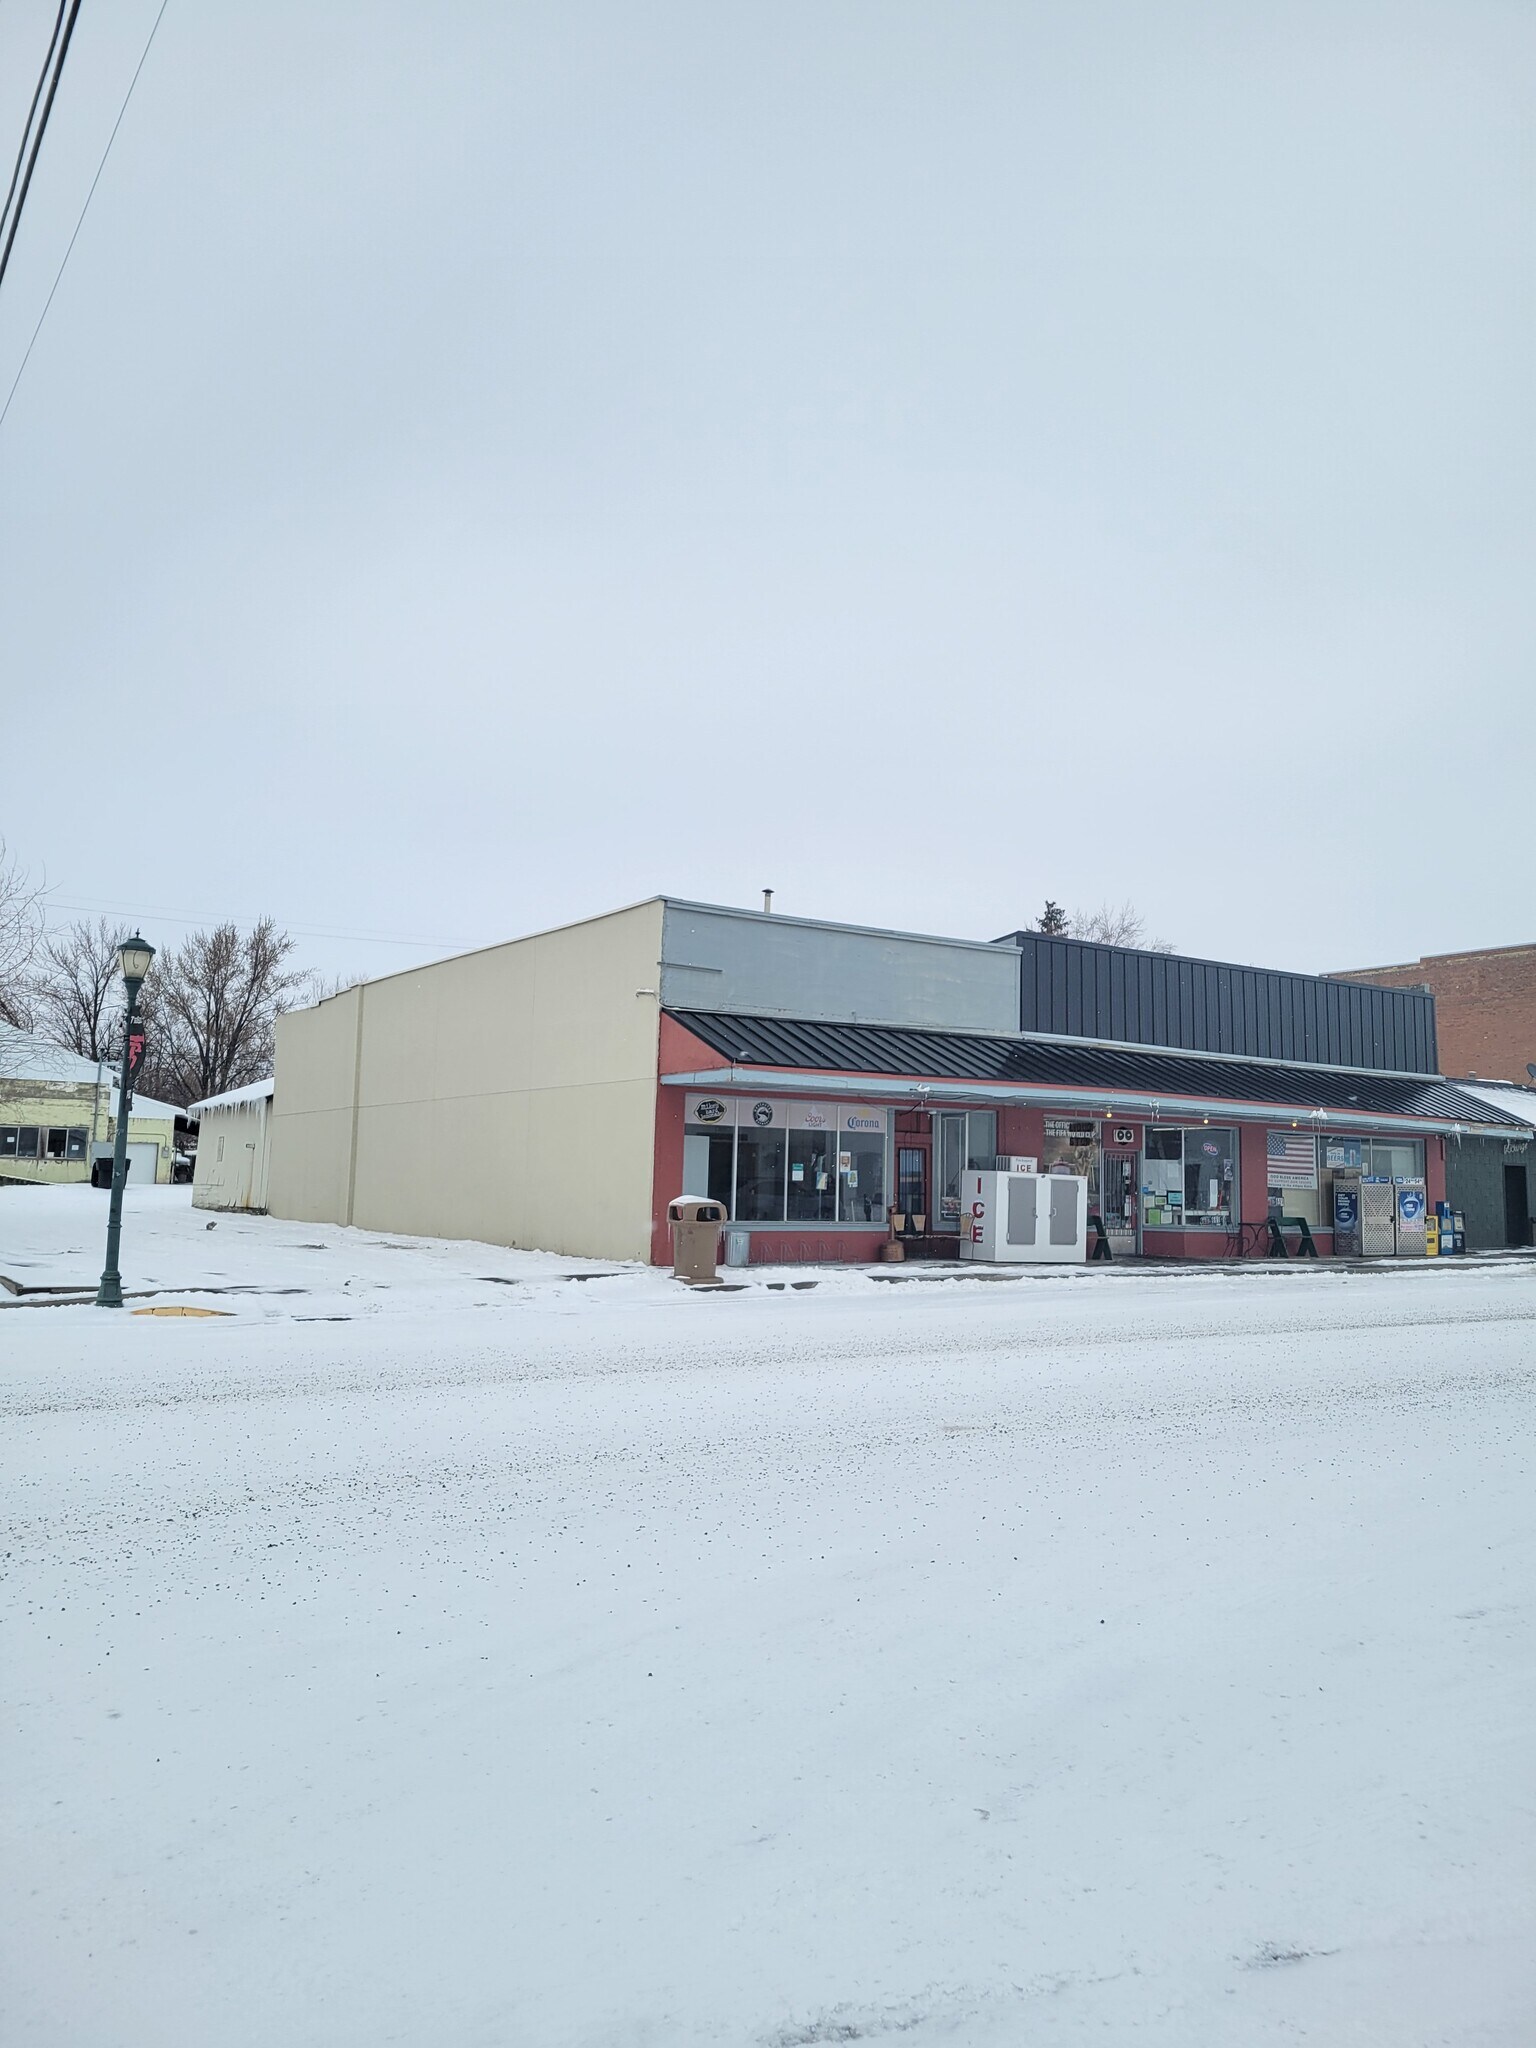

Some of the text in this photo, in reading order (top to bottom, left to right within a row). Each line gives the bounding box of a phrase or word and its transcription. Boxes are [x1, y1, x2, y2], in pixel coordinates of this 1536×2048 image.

[847, 1115, 880, 1130] Corona
[1045, 1121, 1055, 1129] THE
[1045, 1129, 1056, 1137] THE
[1056, 1129, 1067, 1137] FIFA
[1016, 1164, 1032, 1173] ICE
[972, 1176, 985, 1244] ICE
